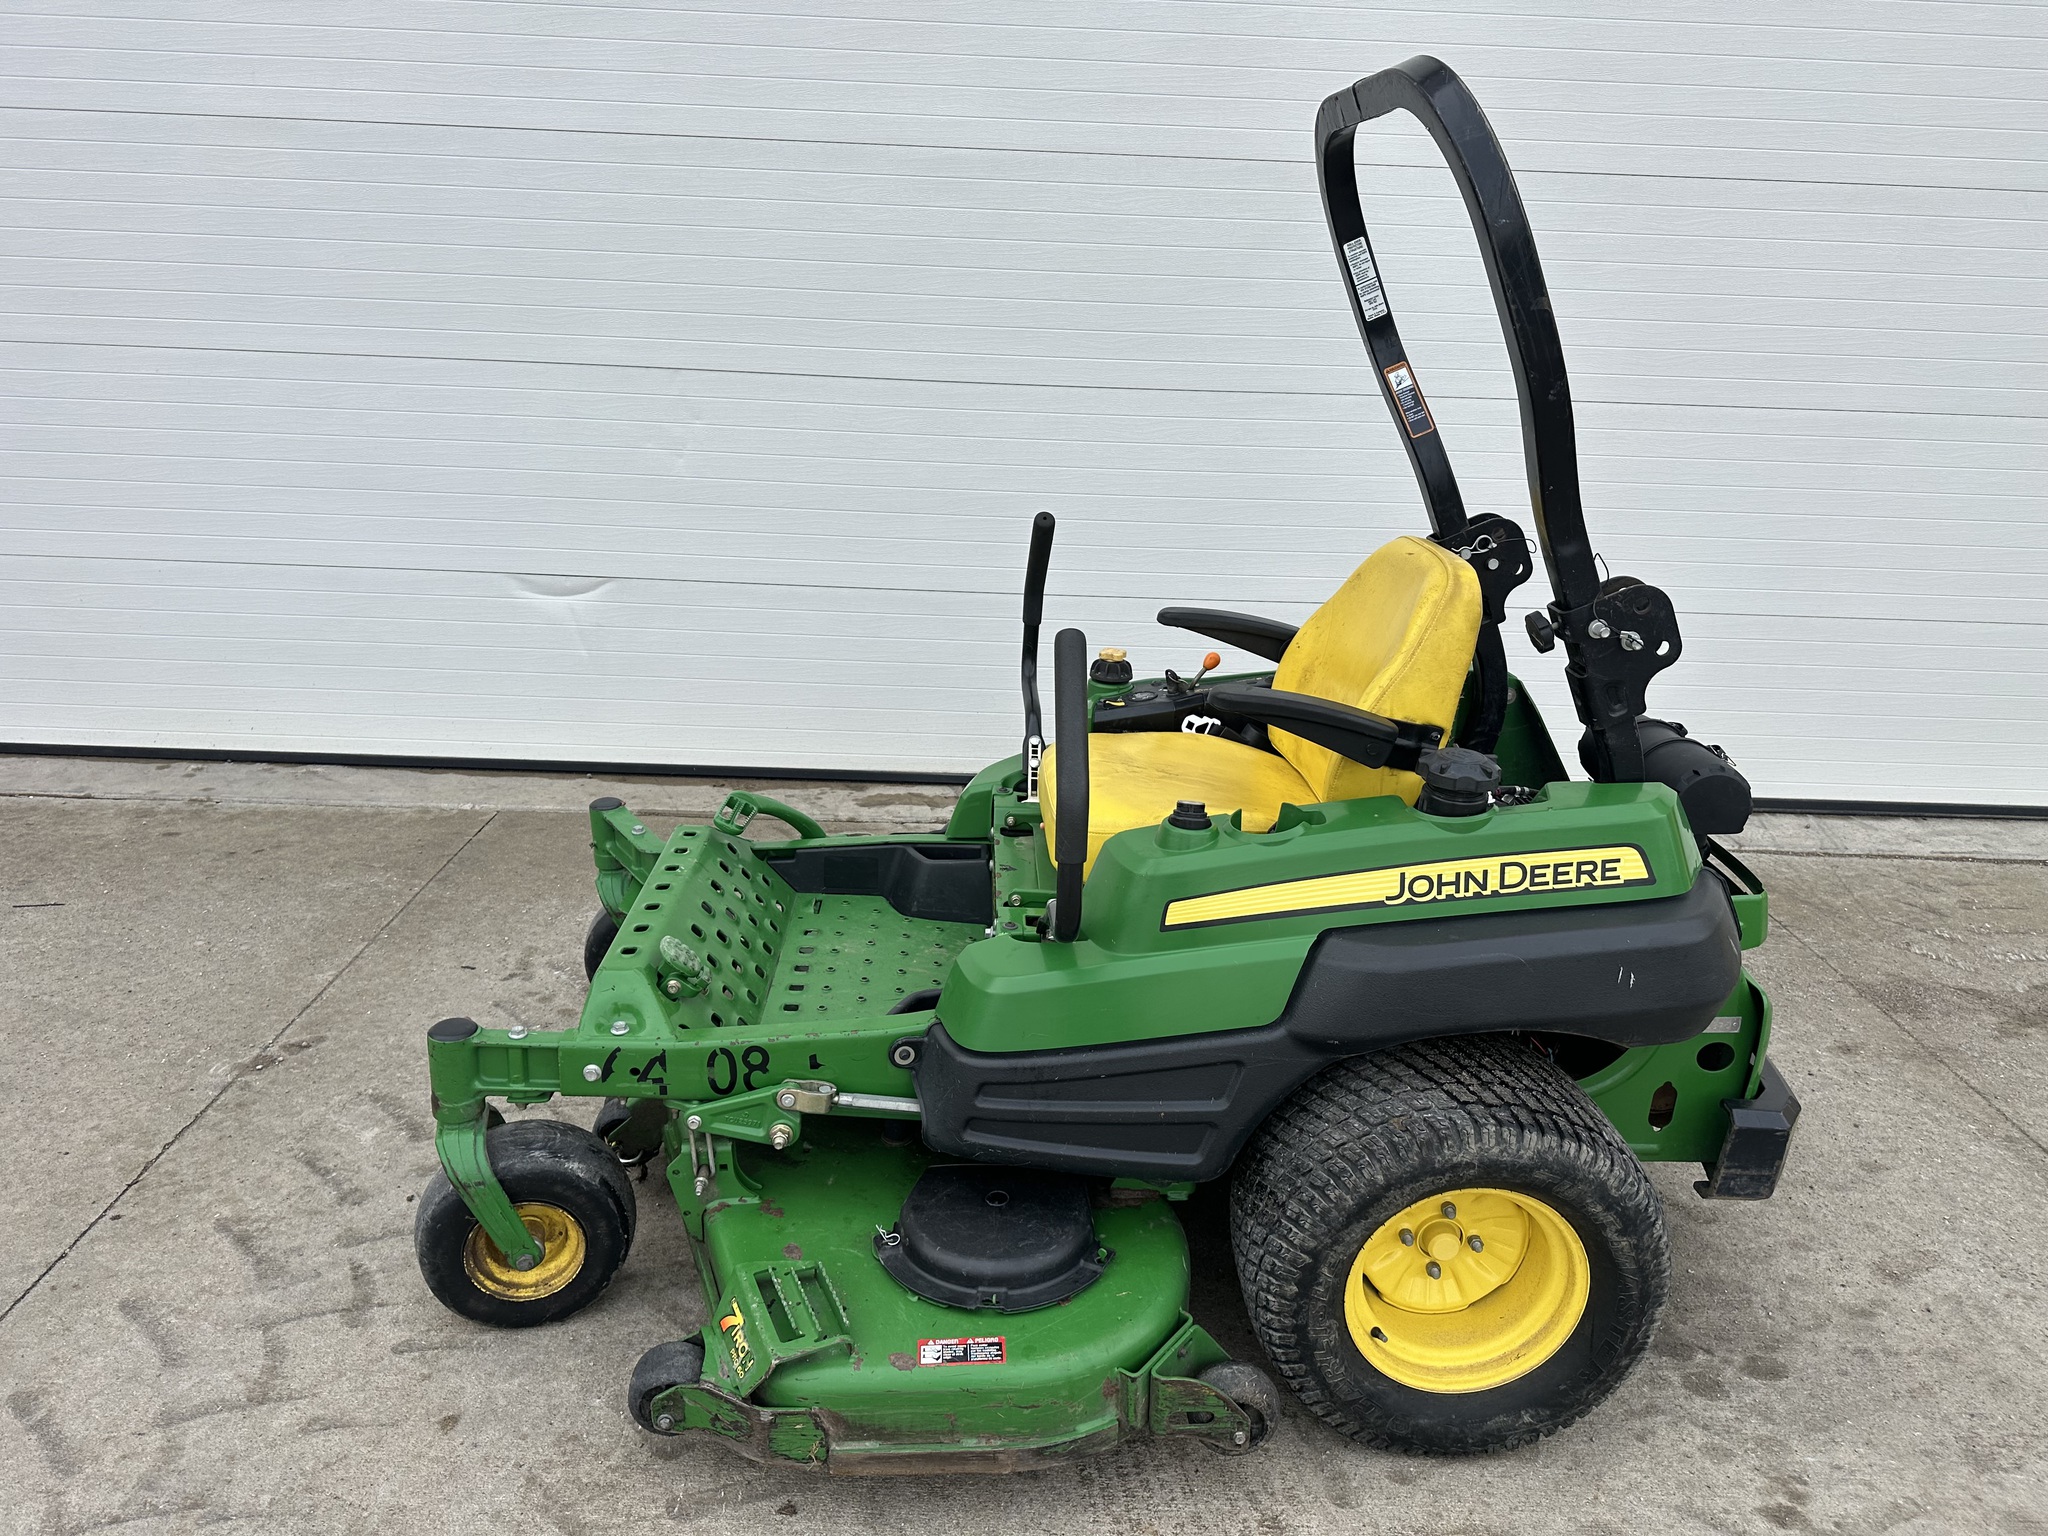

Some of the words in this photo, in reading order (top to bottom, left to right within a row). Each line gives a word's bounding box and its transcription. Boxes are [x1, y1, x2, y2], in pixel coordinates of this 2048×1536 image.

[1385, 869, 1489, 901] JOHN
[1499, 858, 1621, 890] DEERE
[730, 1348, 739, 1367] PRO
